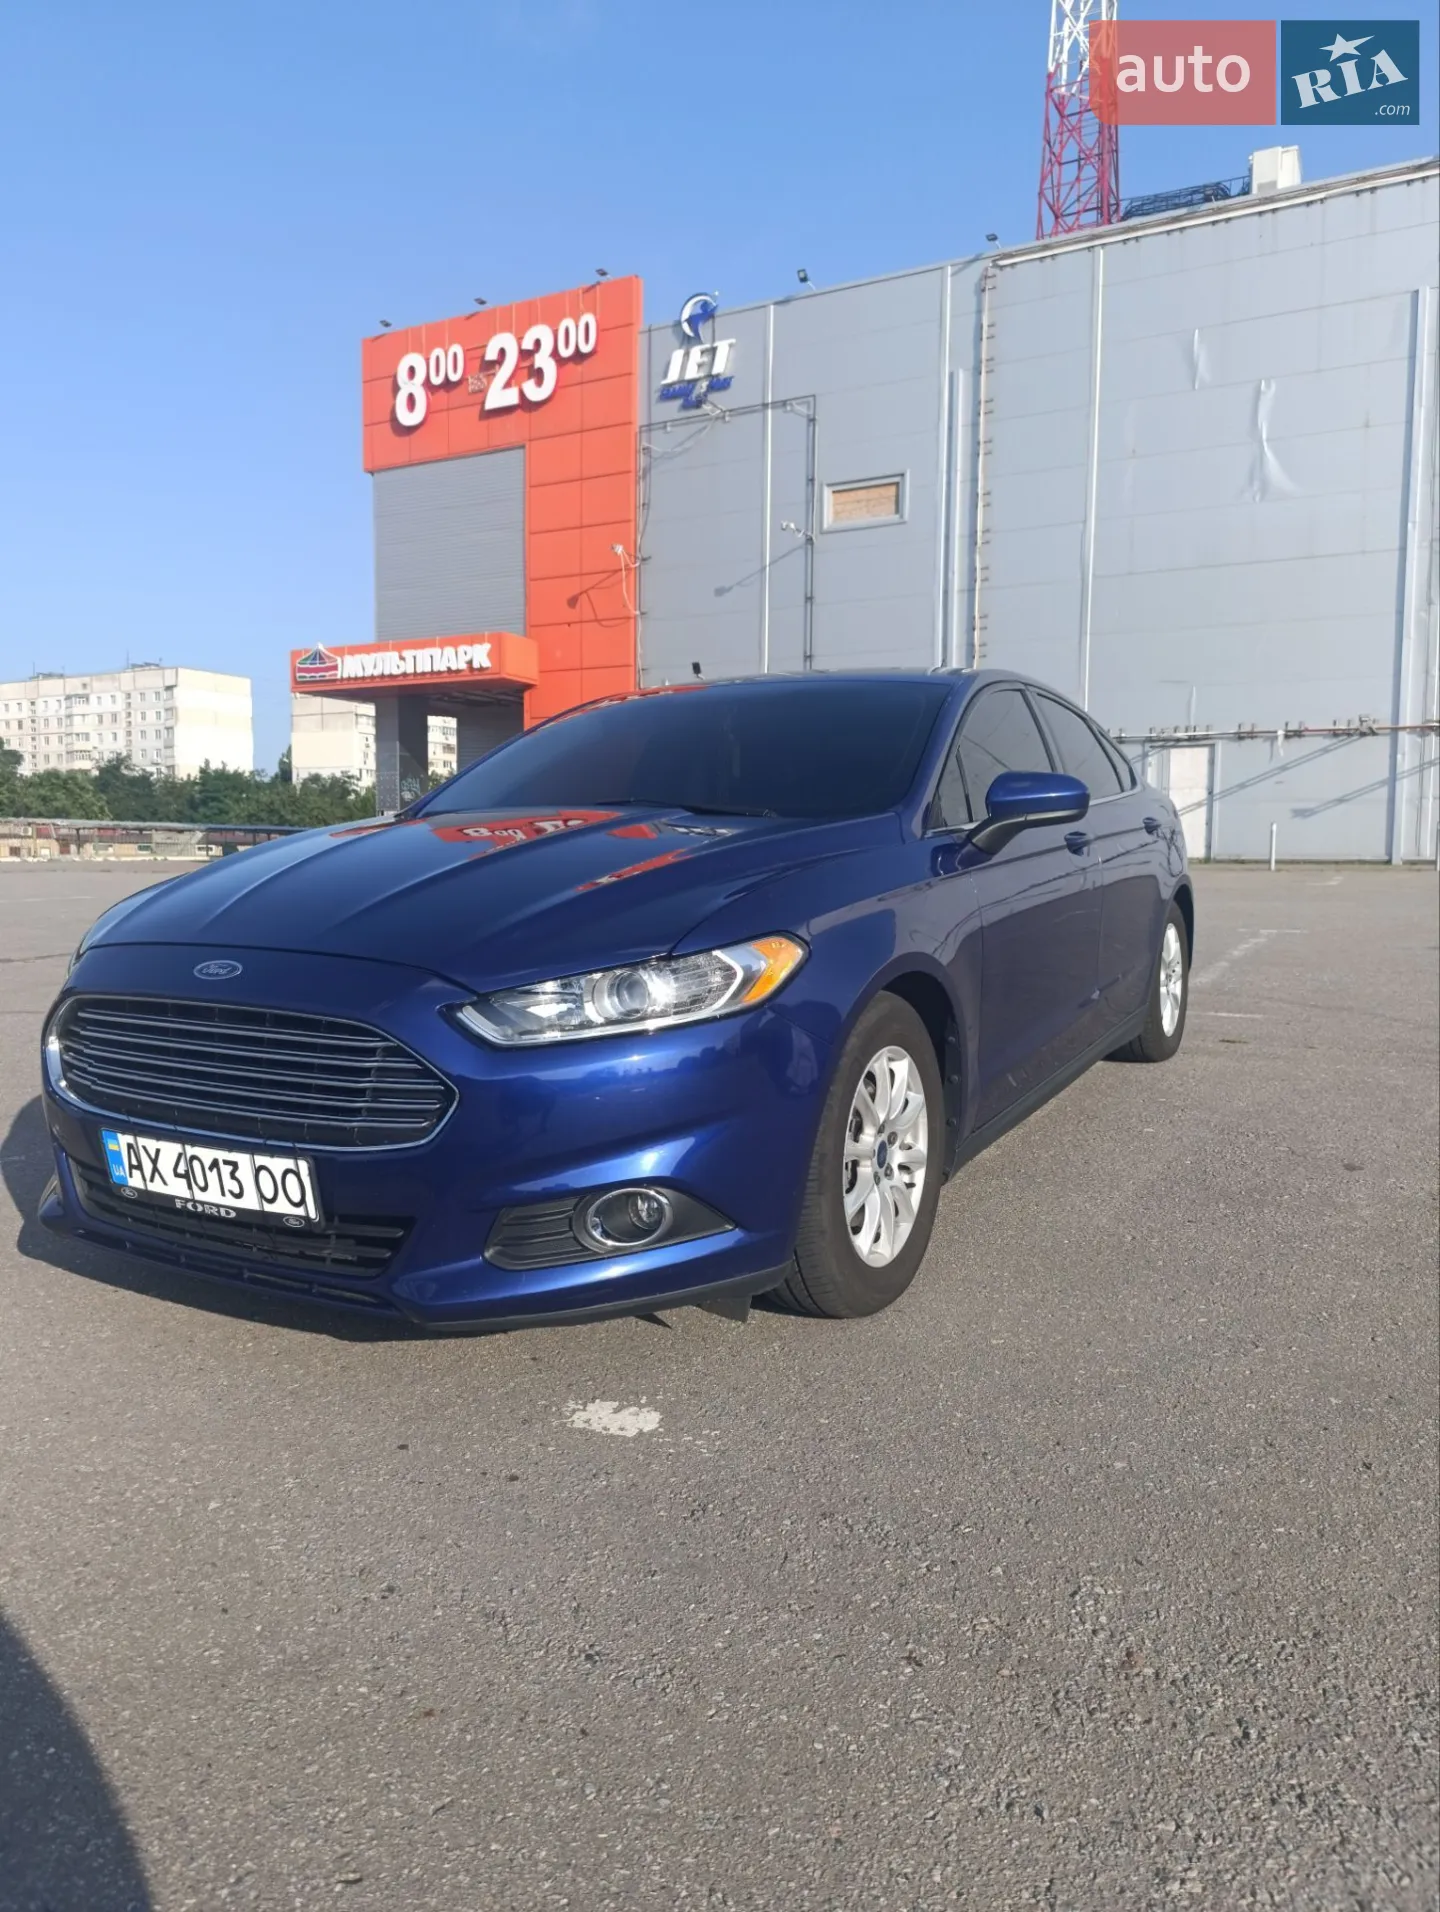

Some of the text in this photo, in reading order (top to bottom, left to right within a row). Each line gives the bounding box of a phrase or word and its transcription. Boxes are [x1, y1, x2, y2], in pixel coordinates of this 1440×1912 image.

[661, 338, 736, 385] JET
[112, 1163, 126, 1178] UA
[126, 1142, 169, 1186] AX
[173, 1152, 244, 1199] 4013
[175, 1198, 237, 1218] FORD
